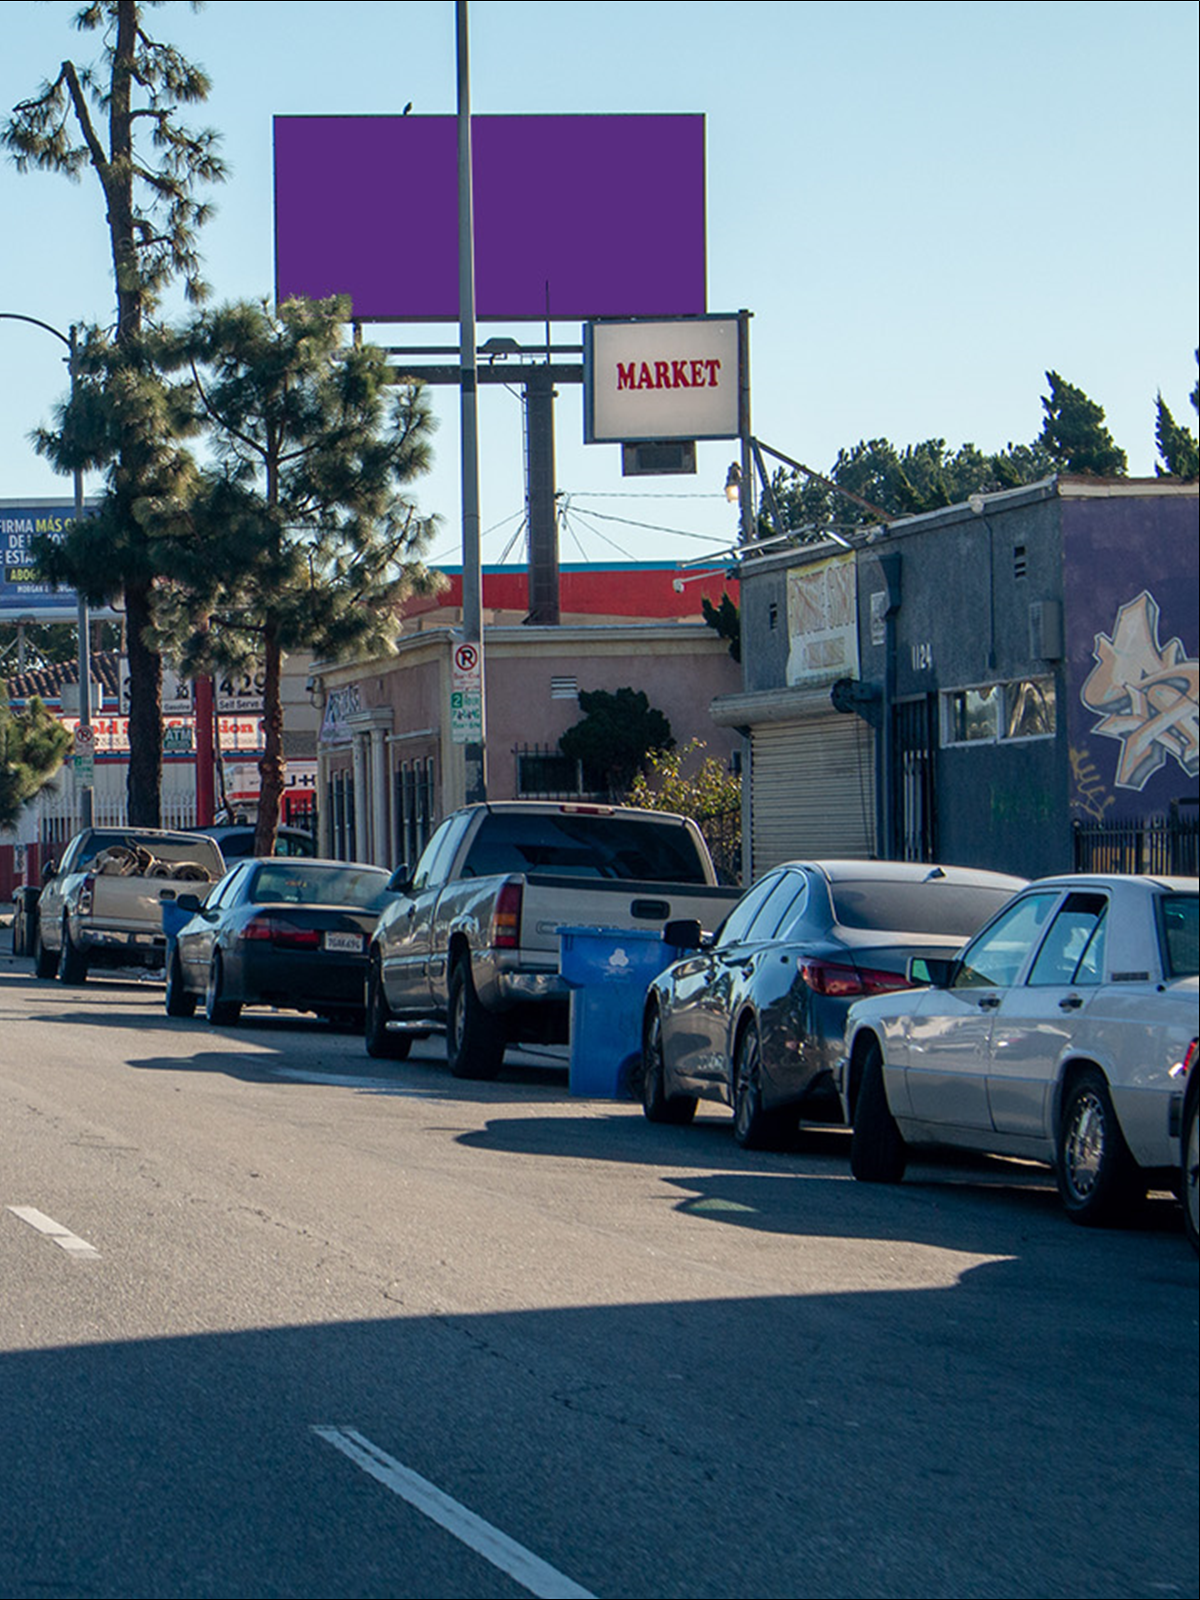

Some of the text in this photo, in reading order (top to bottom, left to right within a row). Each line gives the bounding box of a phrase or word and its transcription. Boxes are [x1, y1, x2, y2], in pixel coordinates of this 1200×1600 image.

[616, 359, 721, 390] MARKET
[35, 515, 62, 532] MÁS
[9, 534, 24, 548] DE
[17, 585, 43, 593] MORGAN
[912, 643, 932, 672] 1124
[219, 700, 259, 710] Self Serve
[453, 694, 461, 705] 2
[164, 703, 191, 711] Gasoline
[165, 729, 192, 740] ATM
